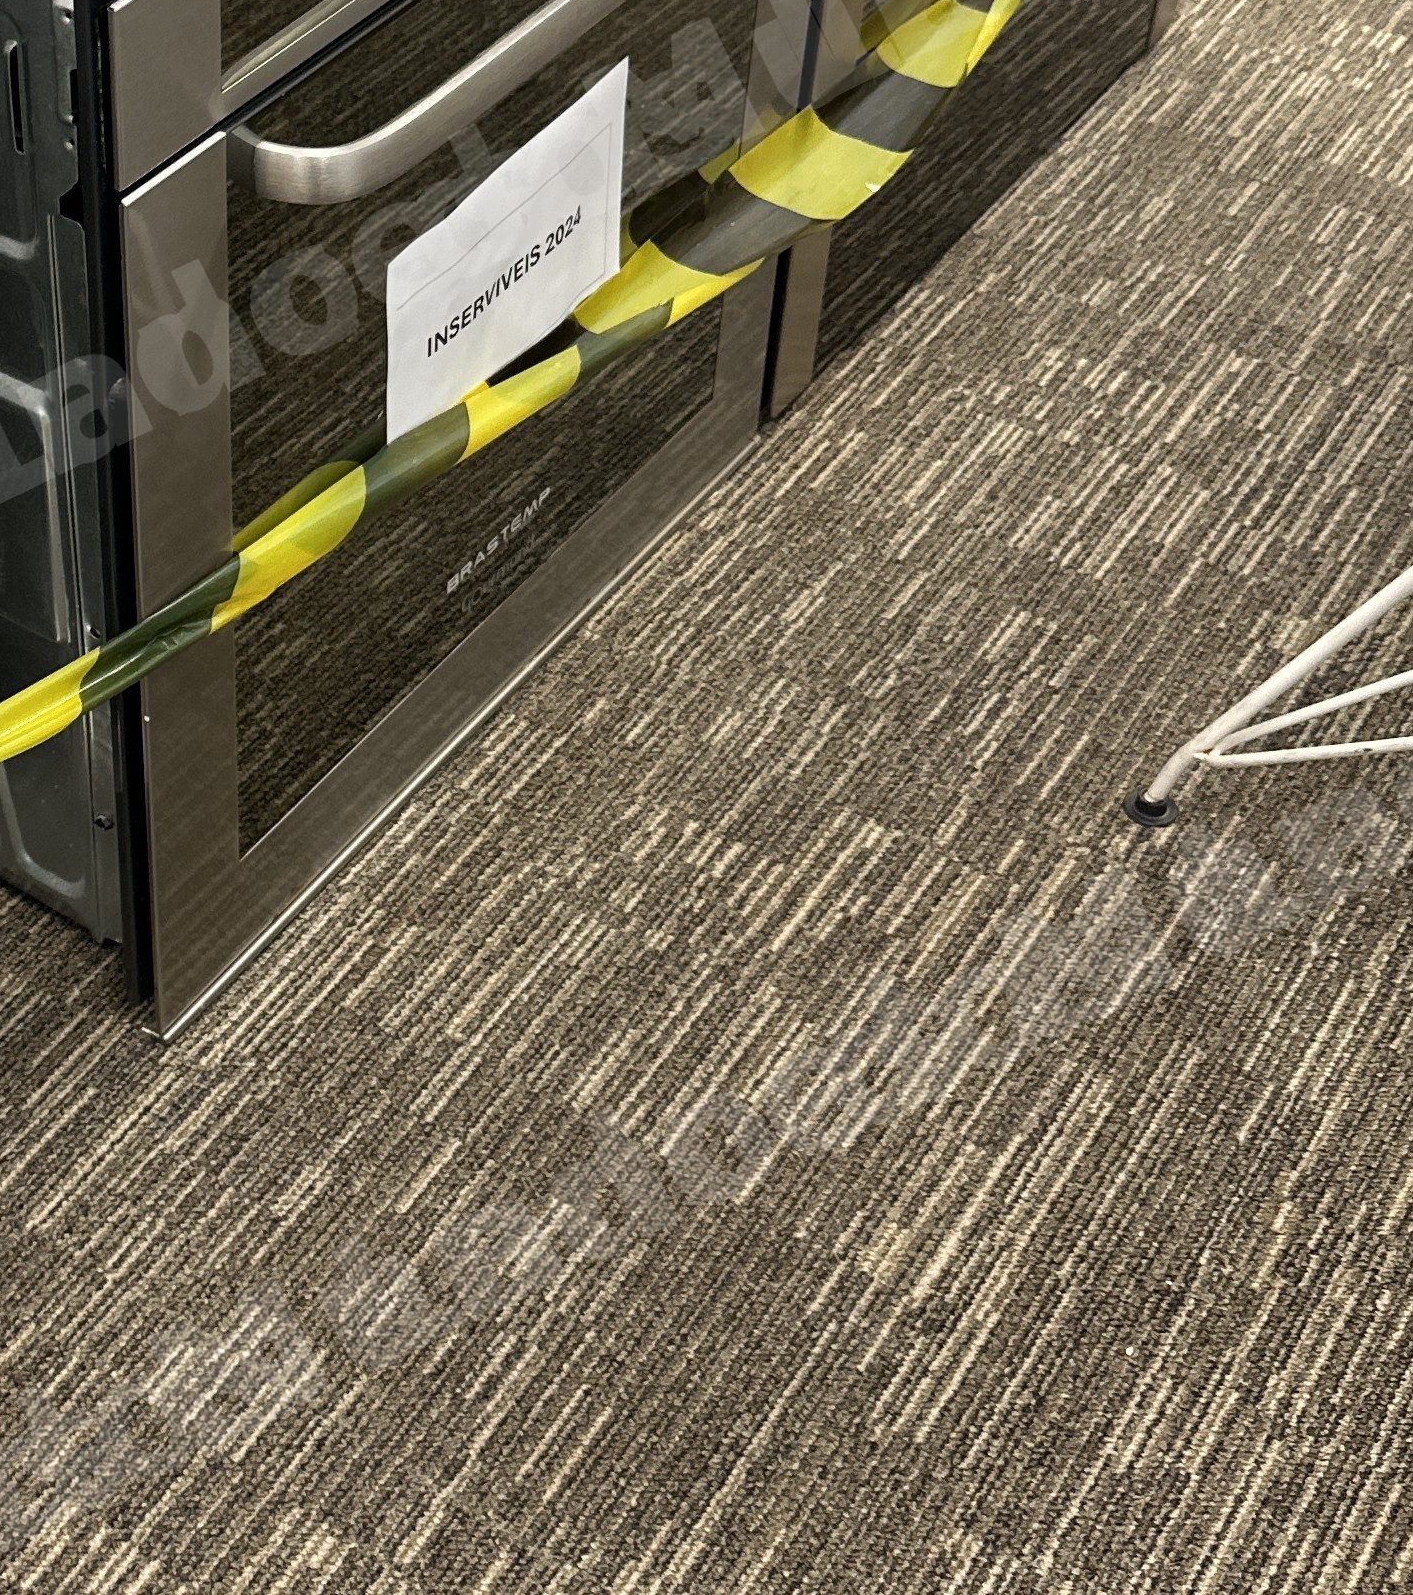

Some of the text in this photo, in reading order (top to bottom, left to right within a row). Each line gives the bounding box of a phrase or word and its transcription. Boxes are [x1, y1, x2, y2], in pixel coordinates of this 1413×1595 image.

[427, 205, 582, 358] INSERVIVEIS 2024
[446, 486, 551, 595] BRASTEMP
